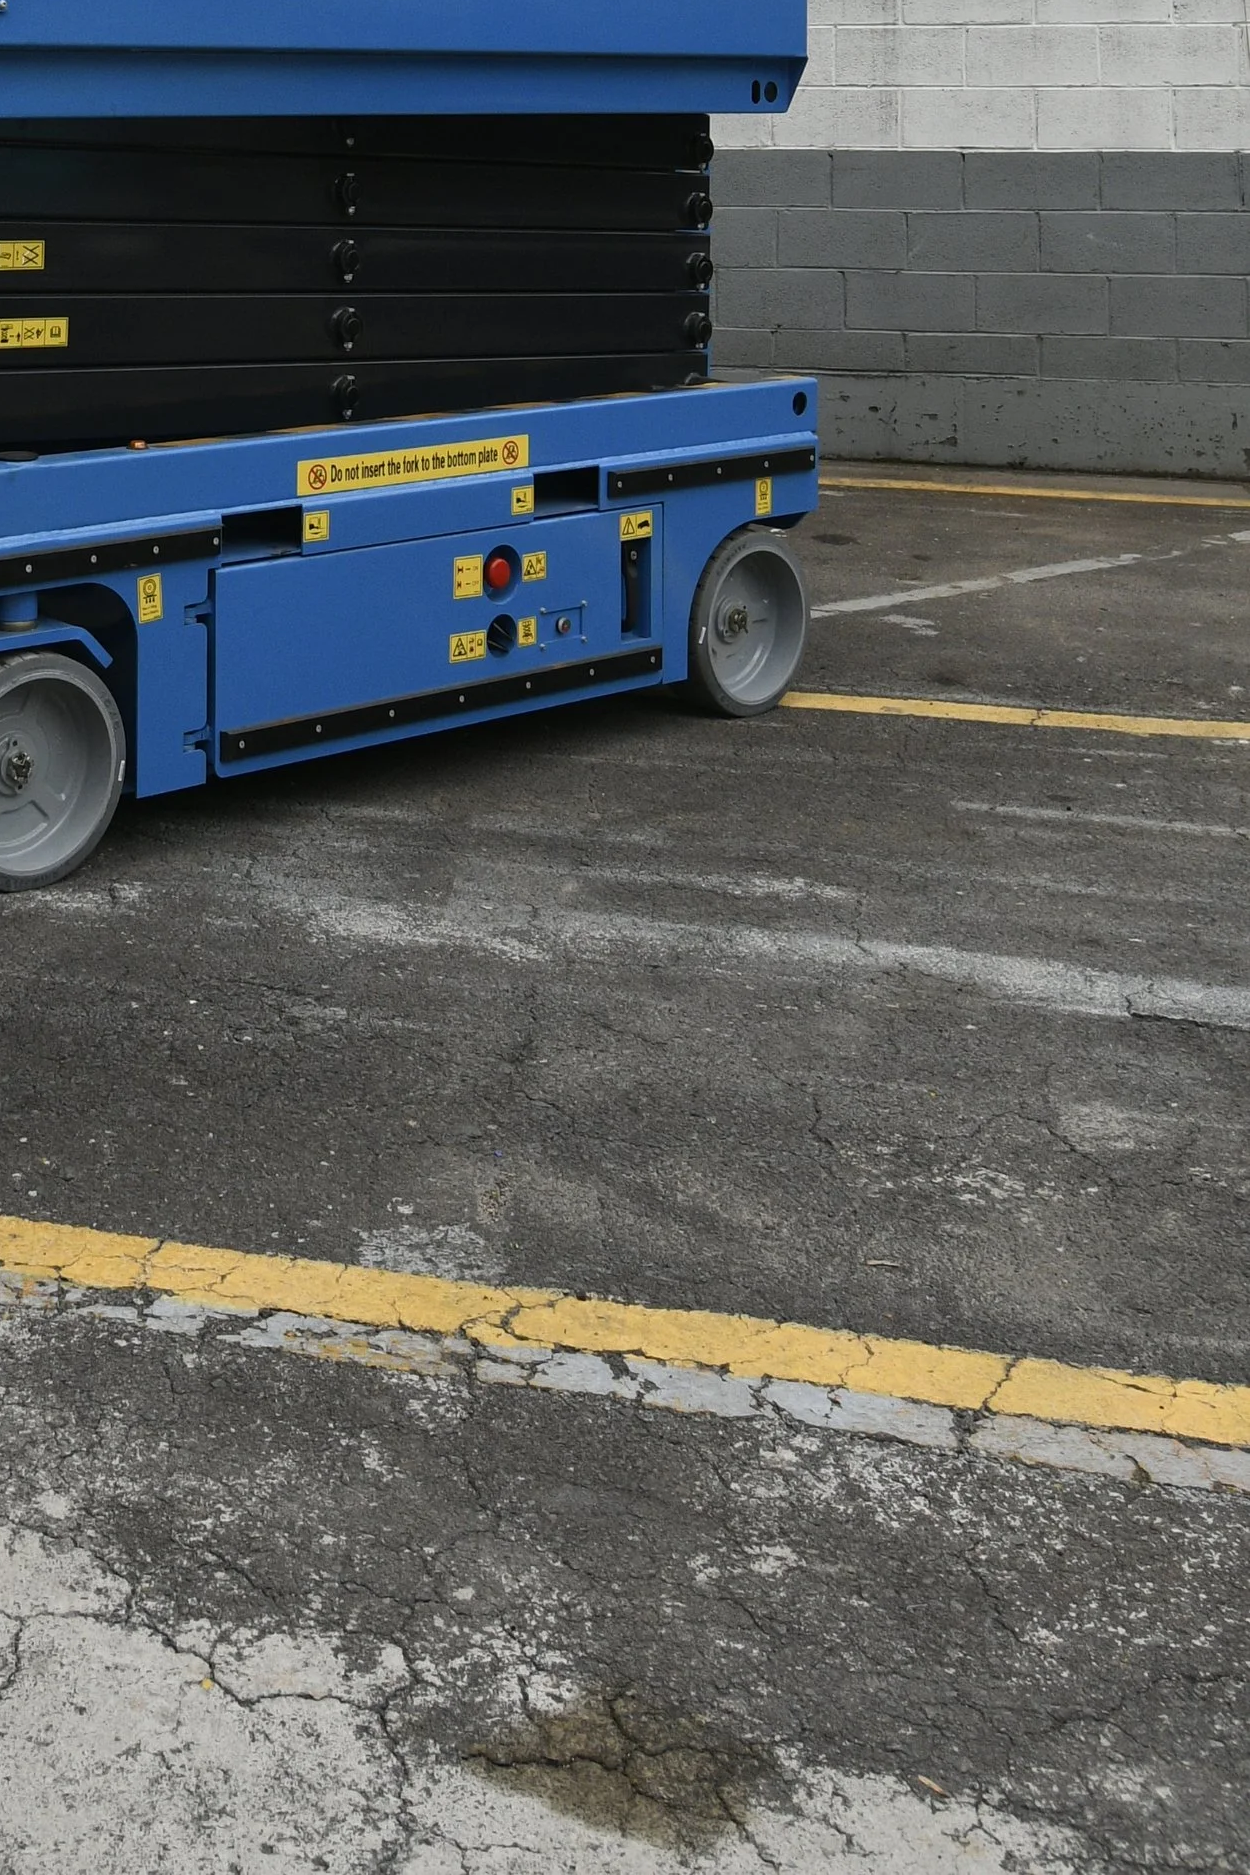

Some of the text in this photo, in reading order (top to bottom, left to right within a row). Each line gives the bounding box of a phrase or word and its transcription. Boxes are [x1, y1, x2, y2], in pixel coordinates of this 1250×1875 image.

[331, 446, 498, 483] Do not insert the fork to the bottom plate
